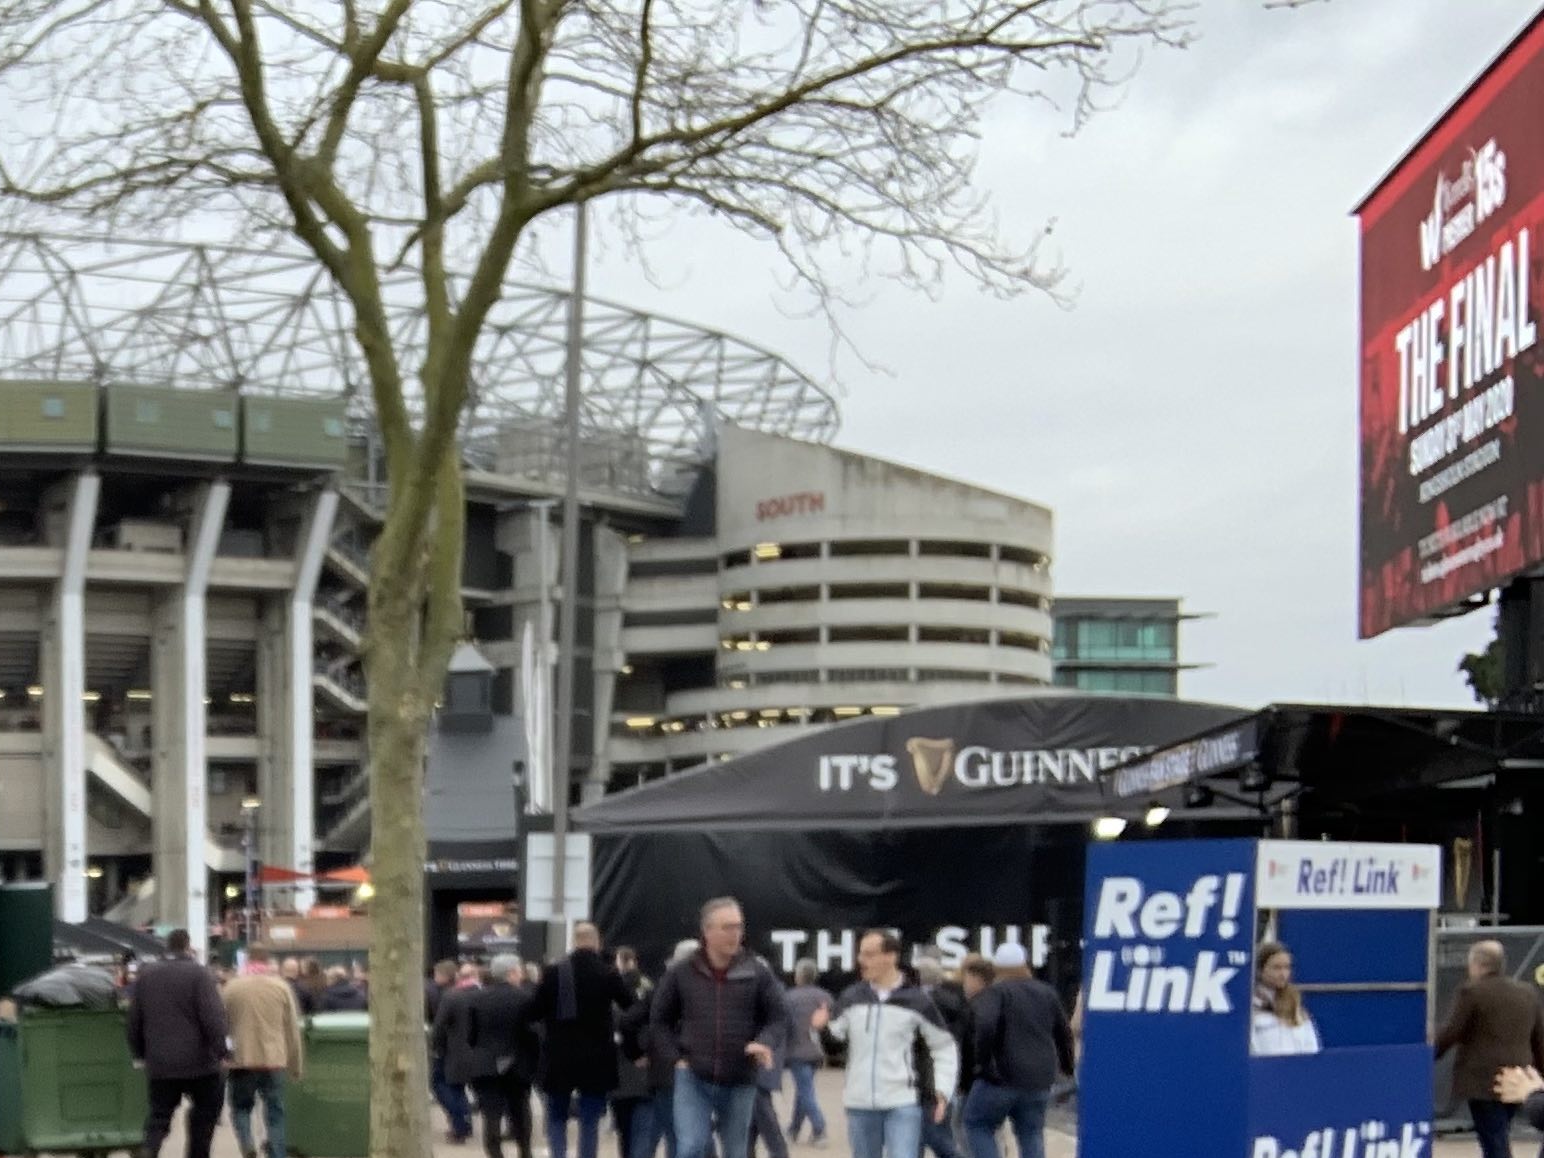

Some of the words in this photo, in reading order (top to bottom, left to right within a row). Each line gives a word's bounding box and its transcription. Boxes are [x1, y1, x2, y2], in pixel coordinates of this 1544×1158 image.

[1396, 298, 1444, 435] THE
[1449, 227, 1536, 399] FINAL
[756, 491, 825, 521] SOUTH
[1297, 858, 1347, 895] Ref!
[1094, 873, 1247, 940] Ref!
